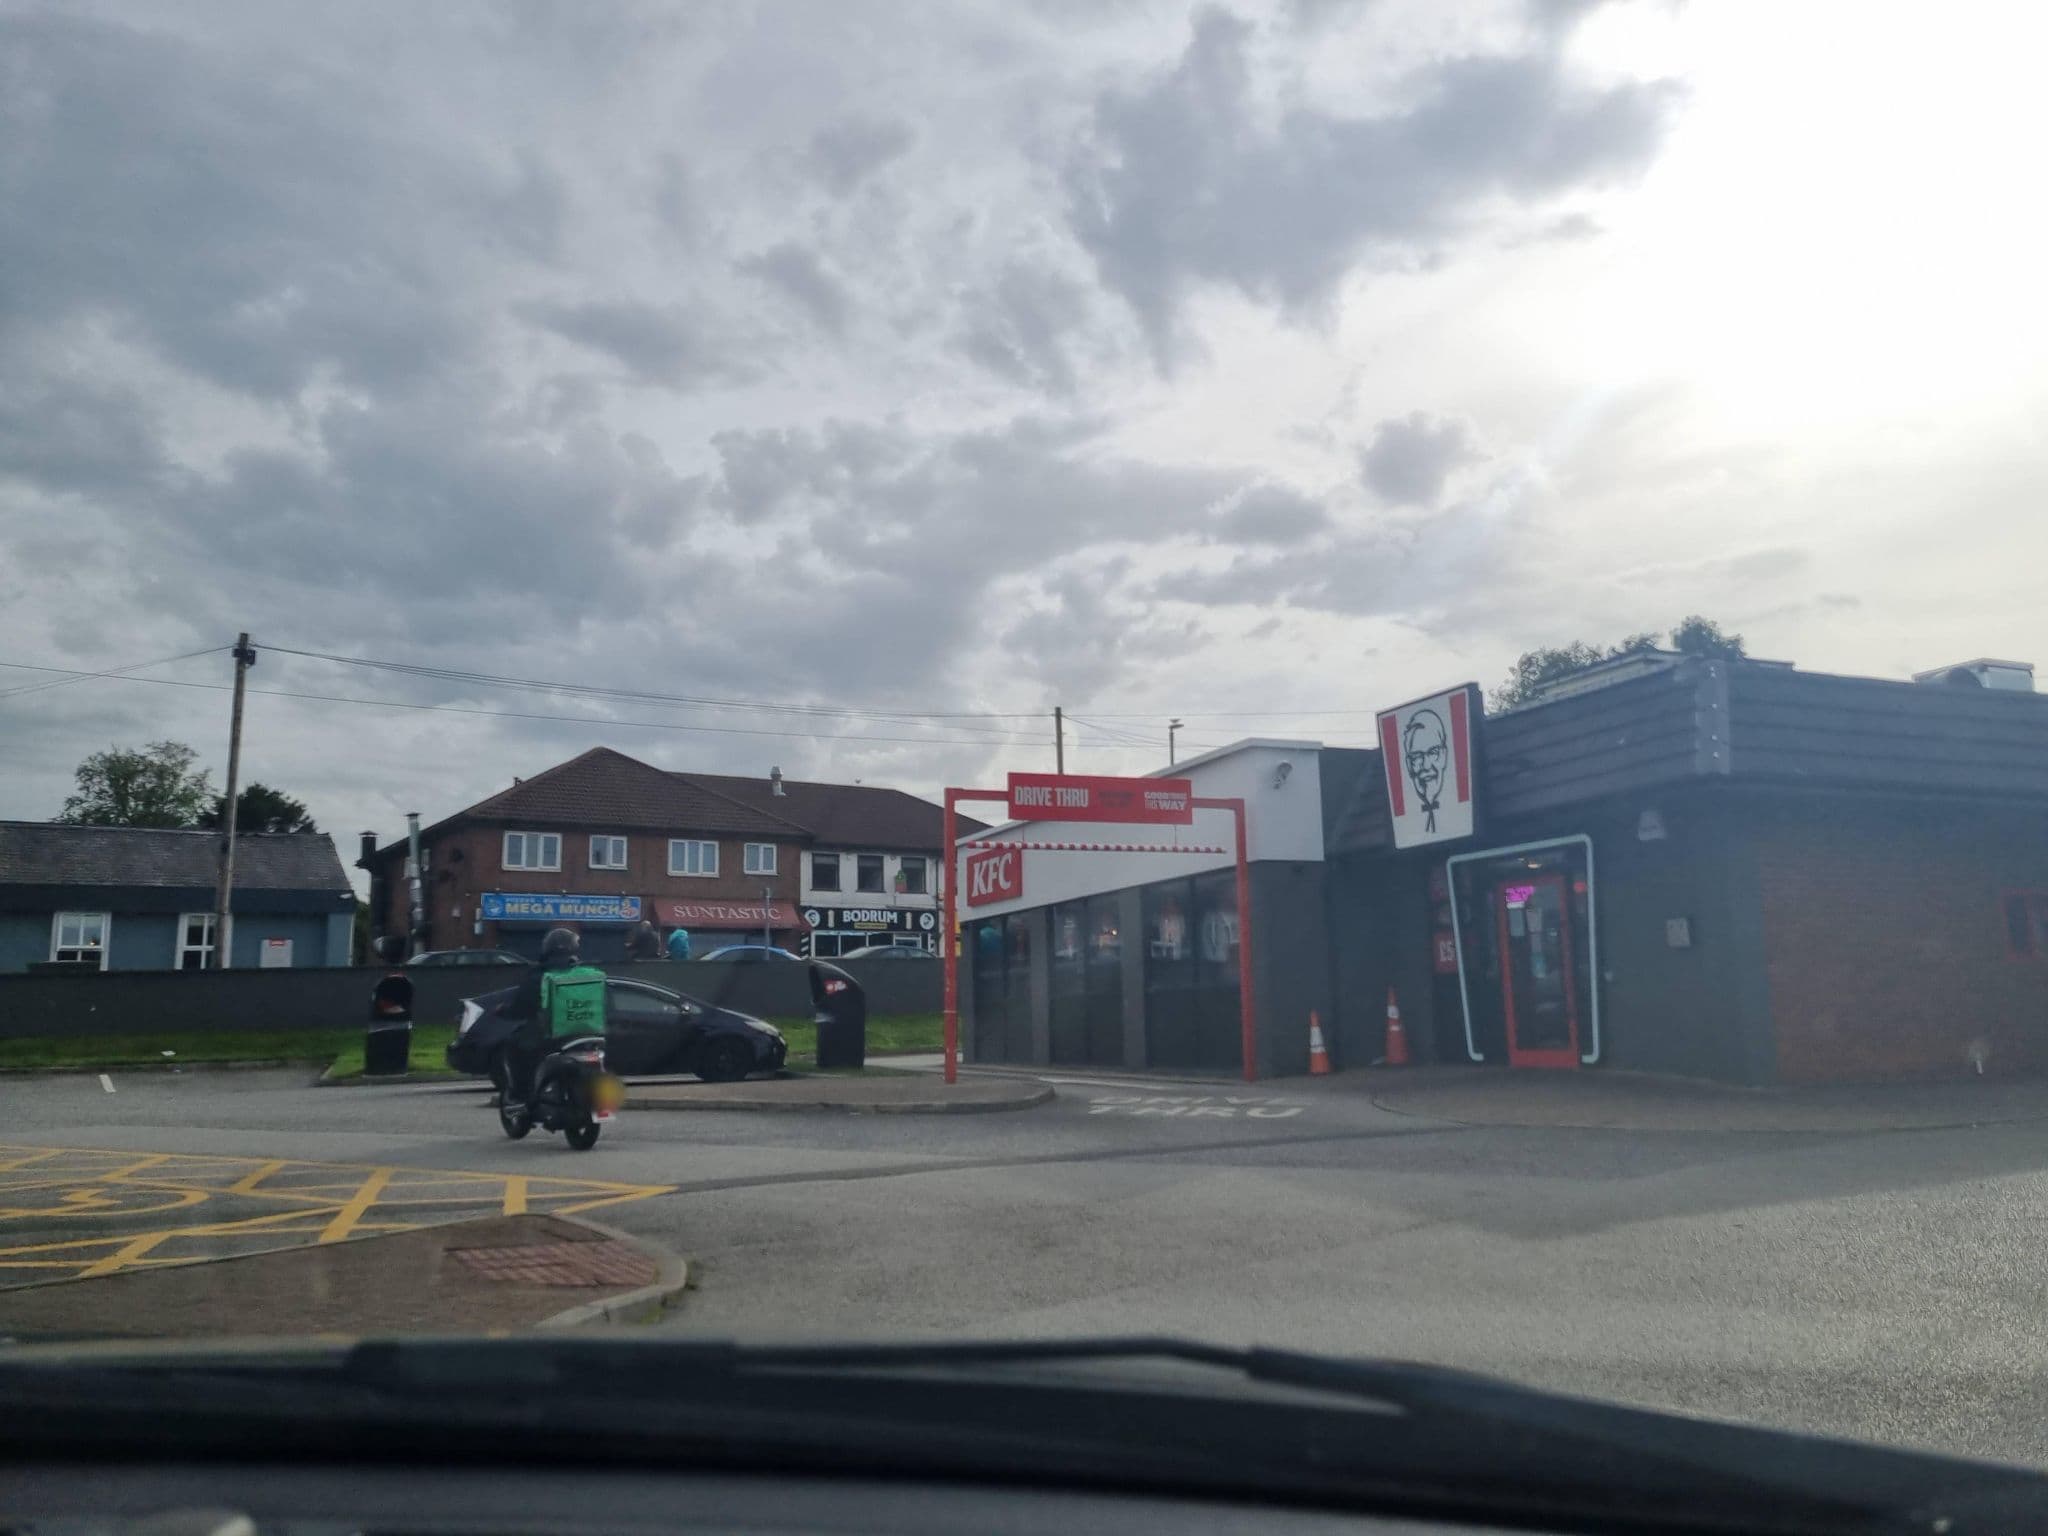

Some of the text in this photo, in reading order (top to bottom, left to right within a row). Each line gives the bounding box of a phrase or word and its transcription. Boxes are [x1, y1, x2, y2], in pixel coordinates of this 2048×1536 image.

[1014, 786, 1053, 806] DRIVE
[1055, 788, 1089, 808] THRU
[1157, 800, 1185, 811] WAY
[971, 852, 1012, 898] KFC
[505, 903, 619, 917] MEGA MUNCH
[673, 905, 782, 920] SUNTASTIC
[843, 910, 899, 925] BODRUM
[567, 1010, 594, 1021] Eats
